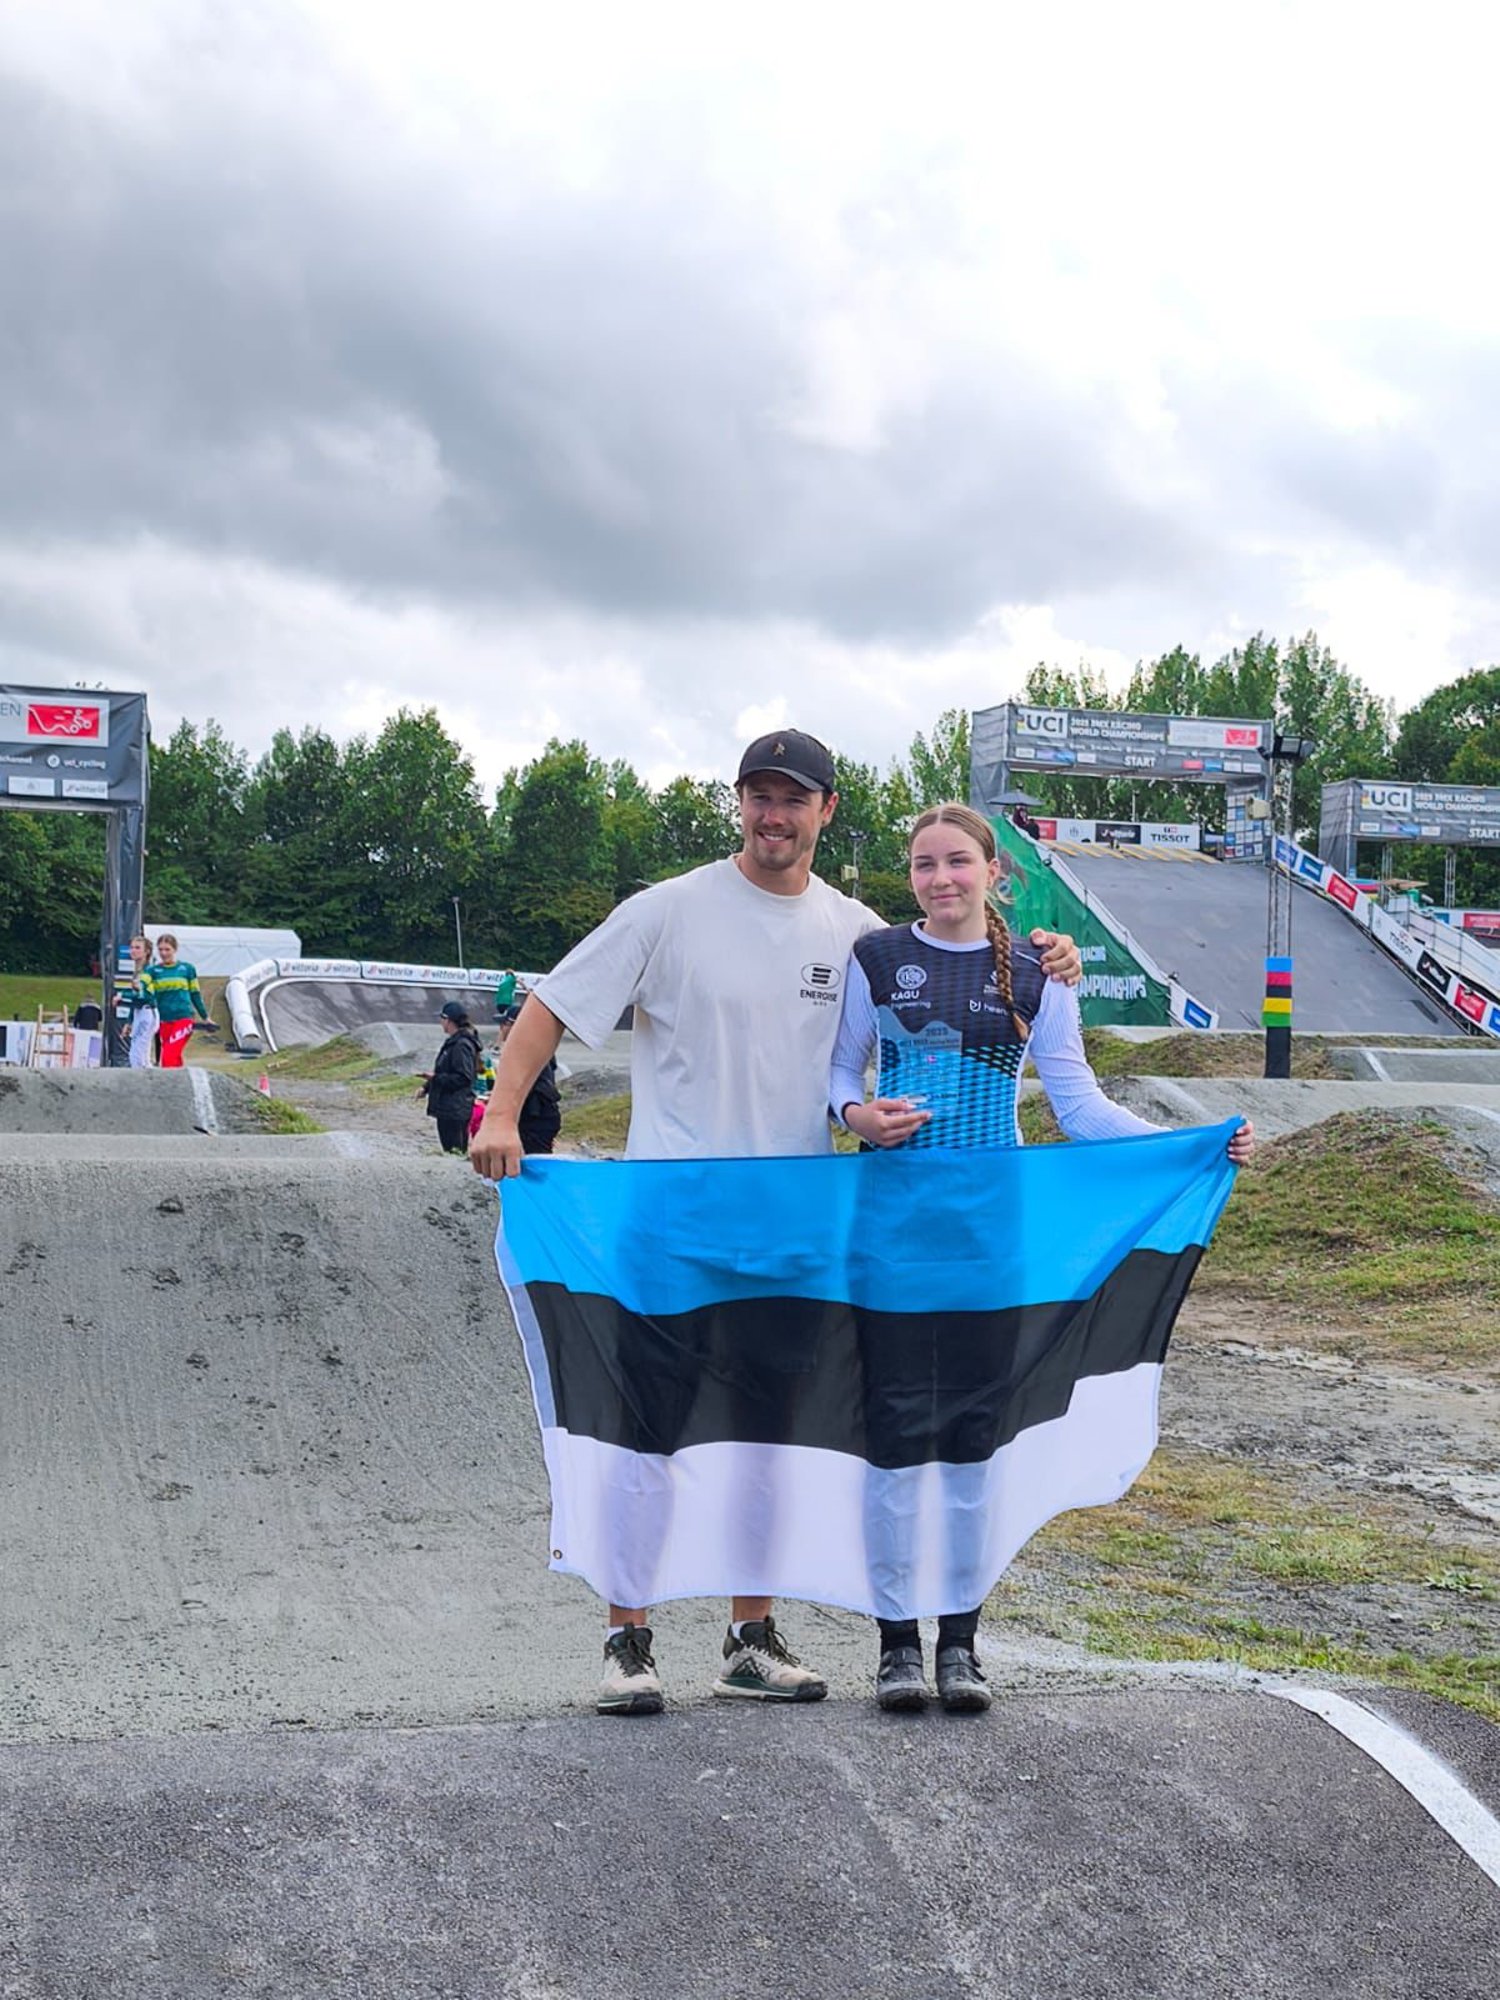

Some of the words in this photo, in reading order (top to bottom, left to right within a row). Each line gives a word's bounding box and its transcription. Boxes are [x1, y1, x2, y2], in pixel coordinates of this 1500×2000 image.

[1026, 714, 1063, 733] UCI
[1111, 721, 1141, 731] RACING
[1071, 727, 1100, 737] WORLD
[1101, 729, 1164, 742] CHAMPIONSHIPS
[1124, 756, 1156, 768] START
[1371, 790, 1407, 807] UCI
[1415, 801, 1443, 810] WORLD
[1151, 834, 1190, 843] TISSOT
[1469, 827, 1500, 839] START
[378, 966, 413, 977] vittoria
[432, 968, 465, 980] vittoria
[1079, 972, 1147, 1000] AMPIONSHIPS
[891, 990, 920, 1001] KAGU
